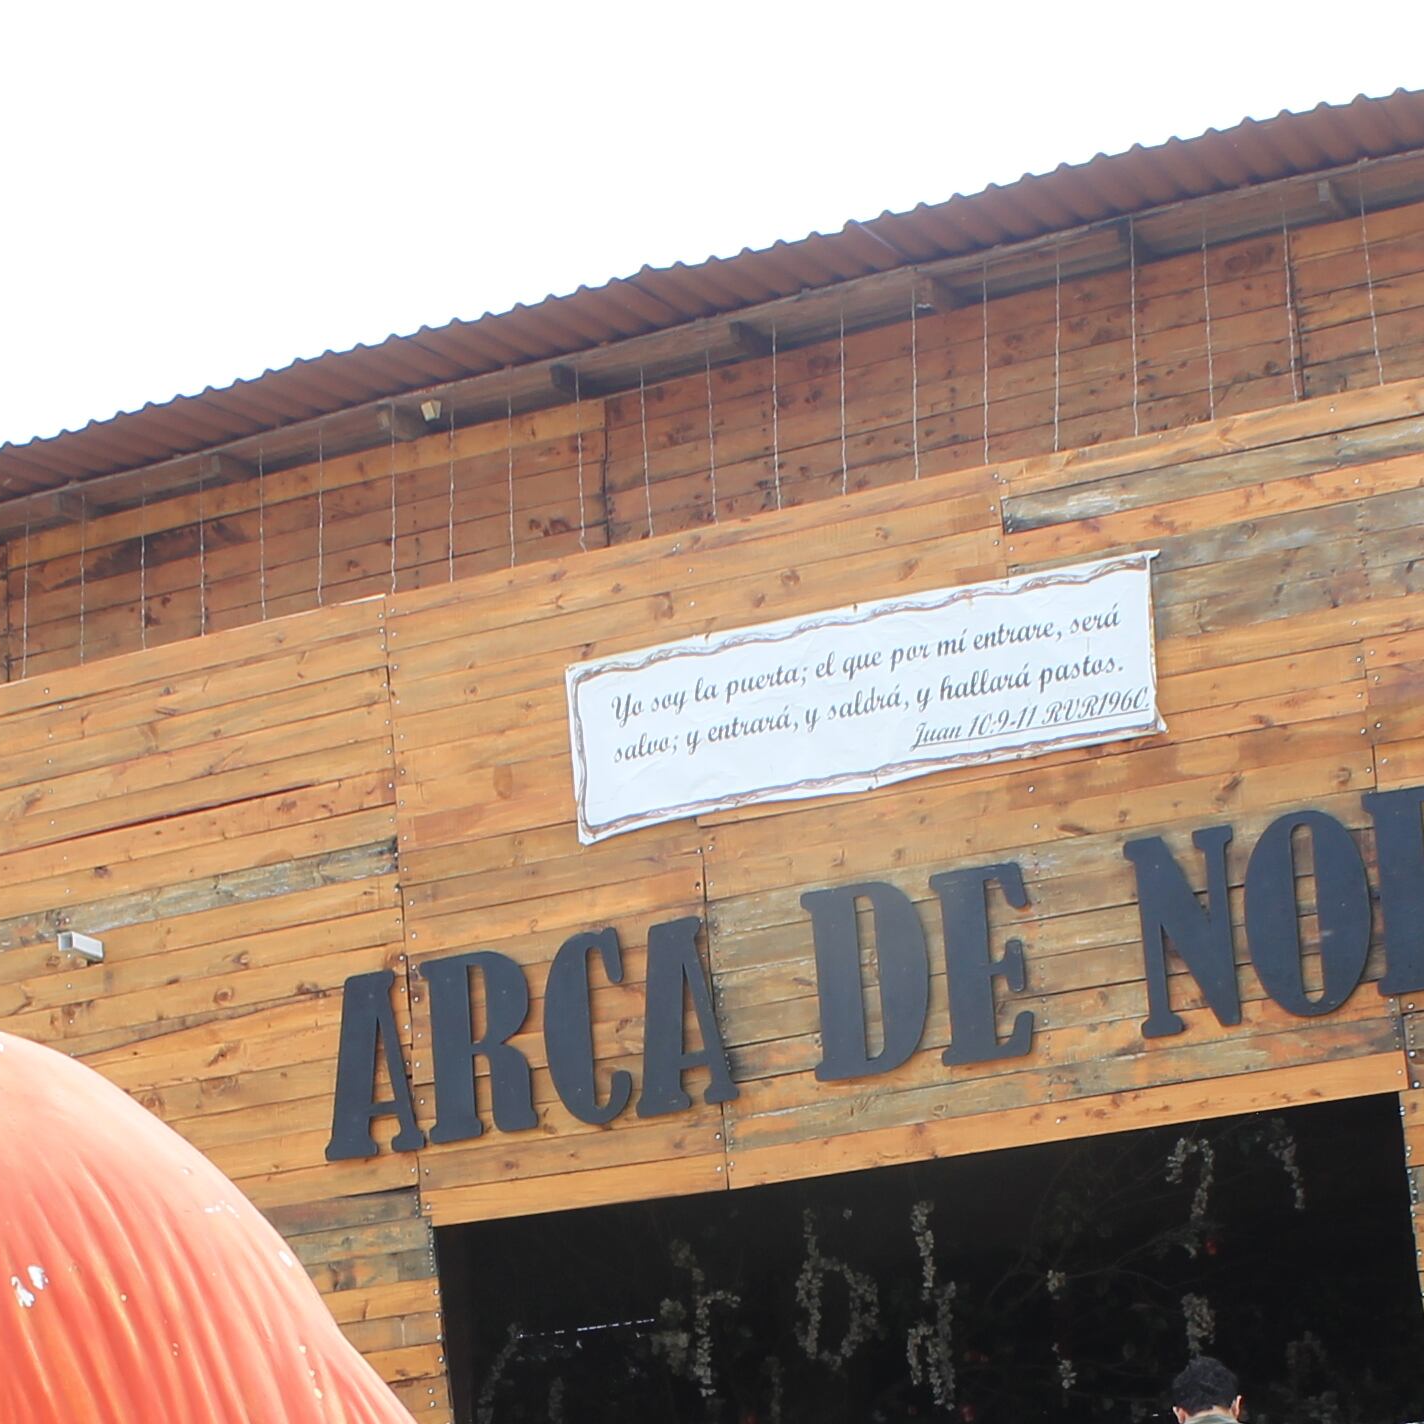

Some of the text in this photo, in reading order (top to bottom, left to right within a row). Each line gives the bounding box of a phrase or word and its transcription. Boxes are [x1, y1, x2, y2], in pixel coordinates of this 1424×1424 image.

[611, 603, 1121, 728] Yo soy la puerta; el que por mí entrare, será
[614, 653, 1124, 763] salvo; y entrará, y saldrá, y hallará pastos.
[910, 722, 962, 752] Juan
[324, 916, 740, 1163] ARCA
[800, 861, 1036, 1084] DE
